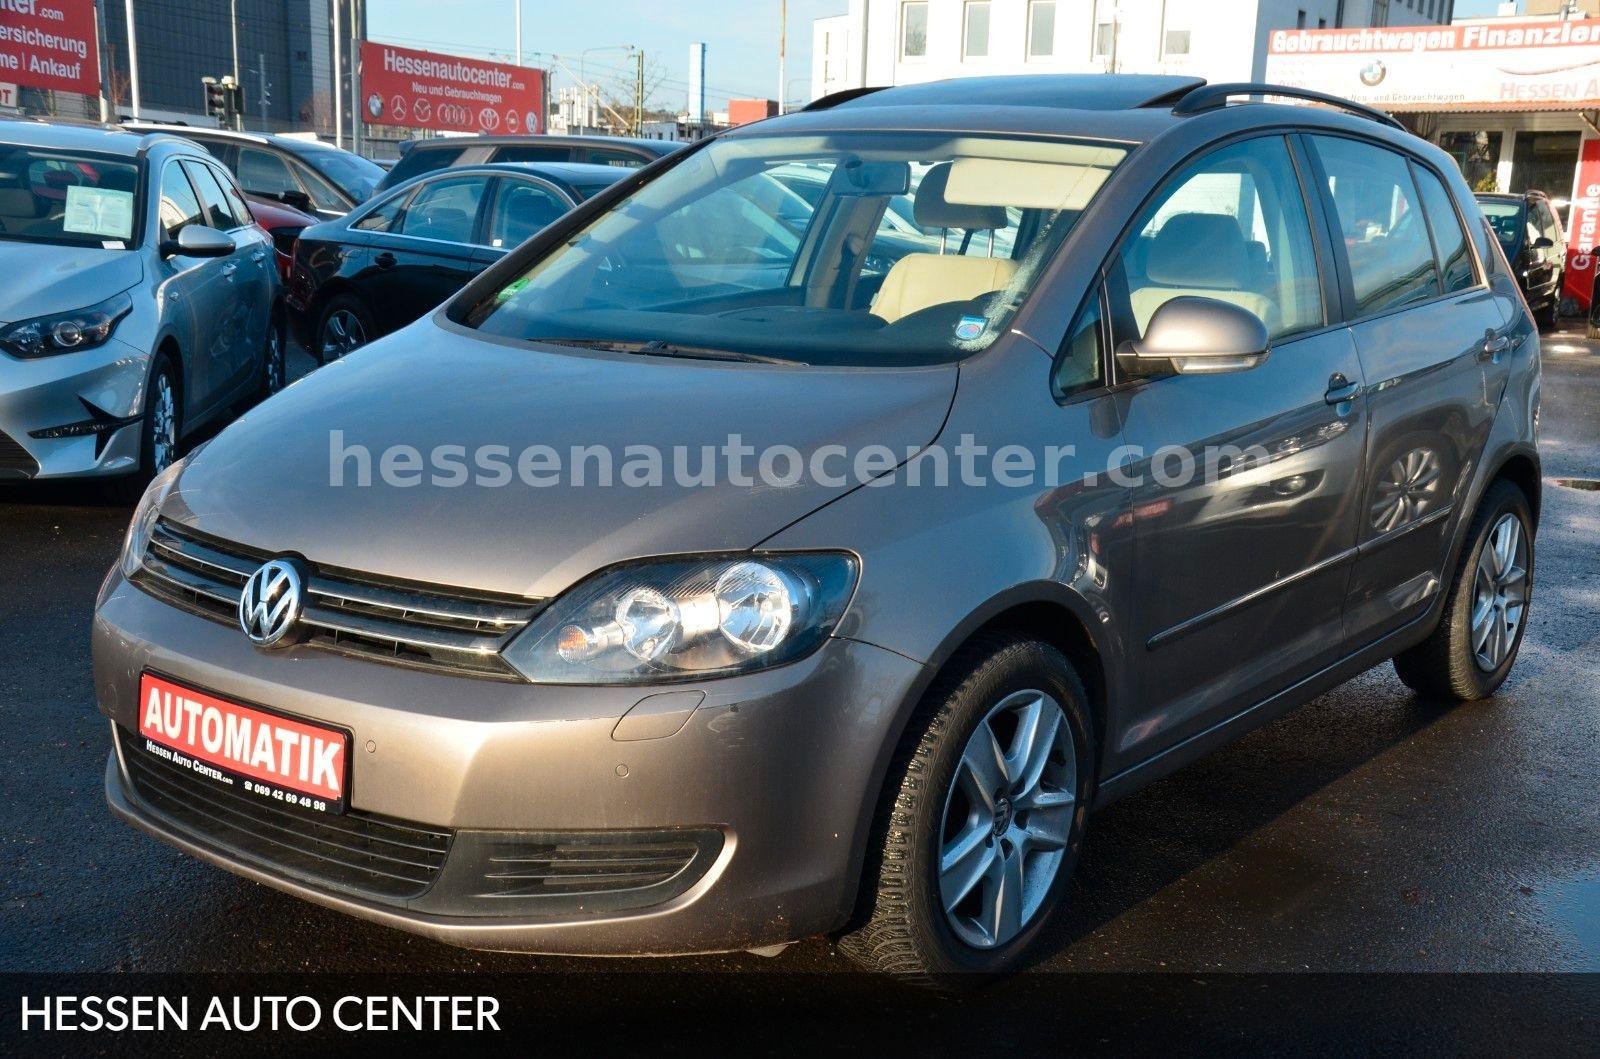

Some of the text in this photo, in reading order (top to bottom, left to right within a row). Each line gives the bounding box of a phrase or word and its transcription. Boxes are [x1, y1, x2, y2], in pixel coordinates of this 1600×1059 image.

[1273, 29, 1456, 52] Gebrauchtwagen
[30, 54, 81, 79] Ankauf
[412, 82, 428, 94] Neu
[429, 84, 443, 96] und
[1500, 82, 1578, 98] HESSEN
[144, 686, 342, 792] AUTOMATIK
[146, 739, 172, 760] HESSEN
[172, 751, 191, 769] AUTO
[254, 783, 270, 797] 069
[271, 788, 284, 800] 42
[285, 792, 298, 804] 69
[299, 796, 311, 808] 48
